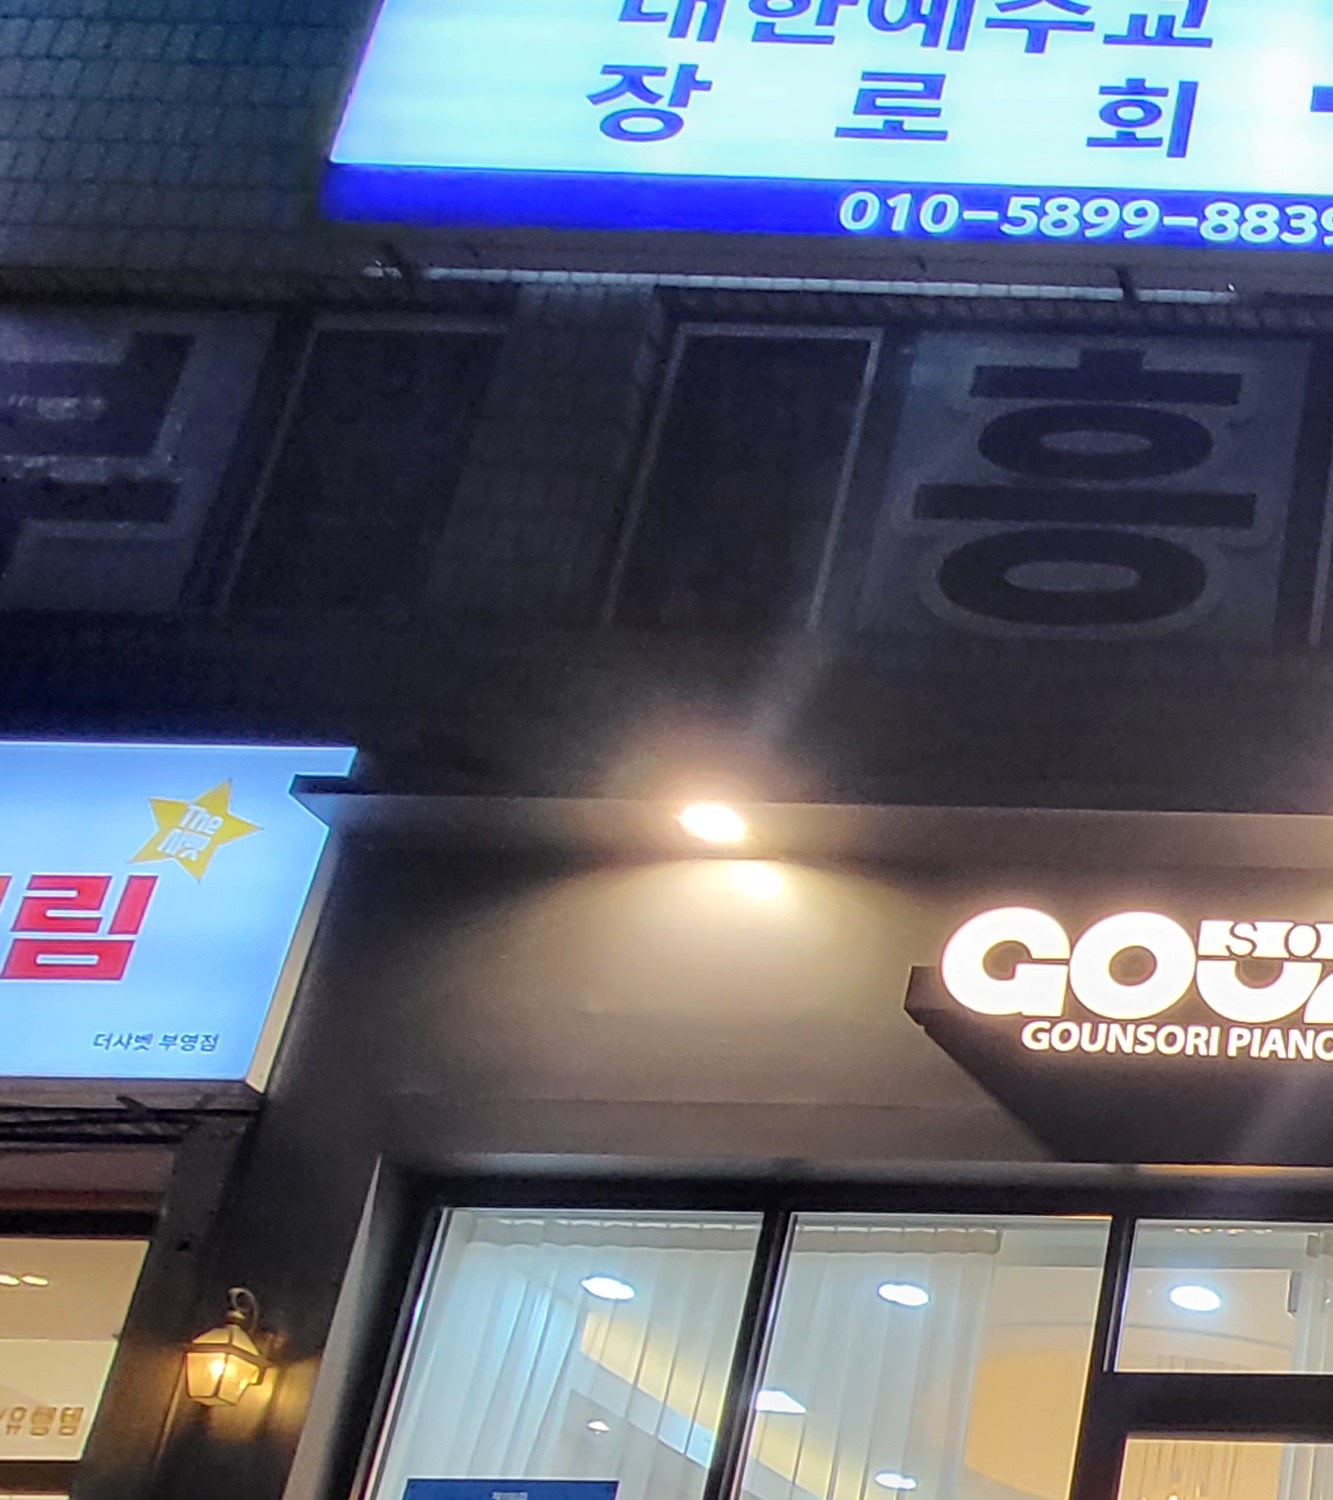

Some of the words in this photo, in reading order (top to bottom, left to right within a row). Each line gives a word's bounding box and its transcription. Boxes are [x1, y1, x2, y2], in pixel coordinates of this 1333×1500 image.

[0, 874, 158, 981] 림
[158, 1033, 220, 1052] 부영점
[1020, 1020, 1222, 1057] GOUNSORI
